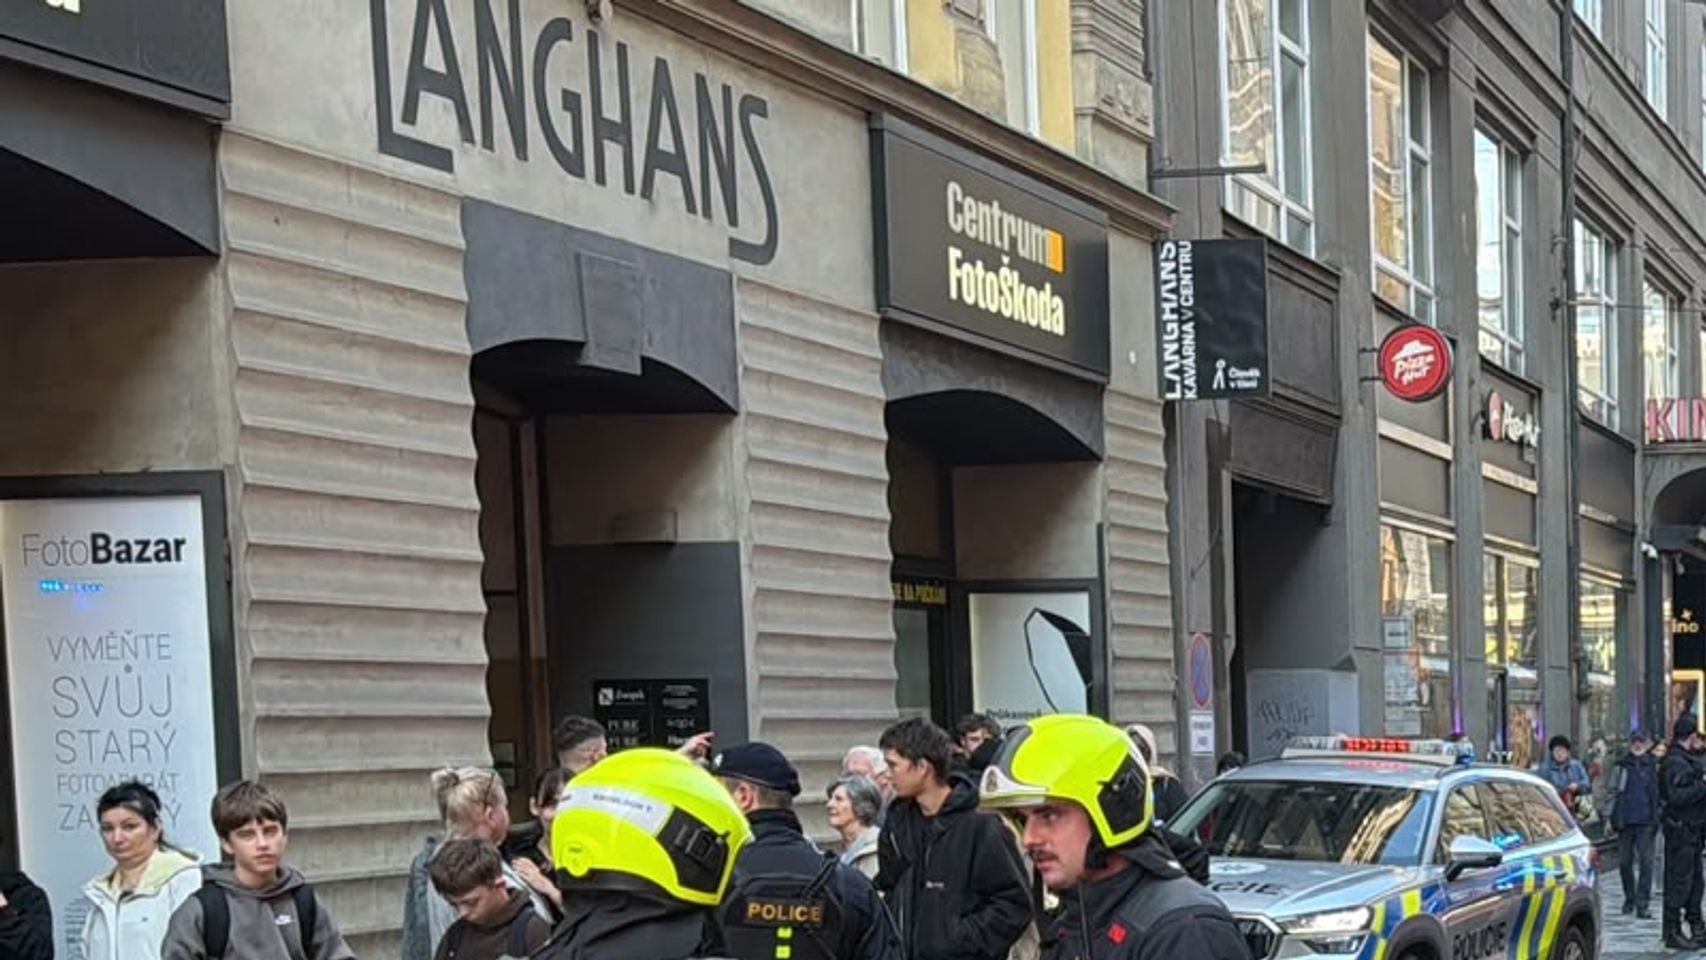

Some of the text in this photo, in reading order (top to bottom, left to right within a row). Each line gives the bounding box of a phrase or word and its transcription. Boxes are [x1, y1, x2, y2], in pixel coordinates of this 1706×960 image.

[369, 0, 779, 266] LANGHANS
[945, 181, 1052, 266] Centrum
[947, 246, 1067, 338] FotoŠkoda
[1178, 239, 1195, 307] CENTRU
[1159, 240, 1182, 400] LANGHANS
[1181, 308, 1194, 320] V
[21, 532, 188, 567] FotoBazar
[47, 631, 173, 662] VYMĚŇTE
[51, 665, 173, 719] SVŮJ
[55, 722, 177, 764] STARÝ
[747, 902, 821, 922] POLICE
